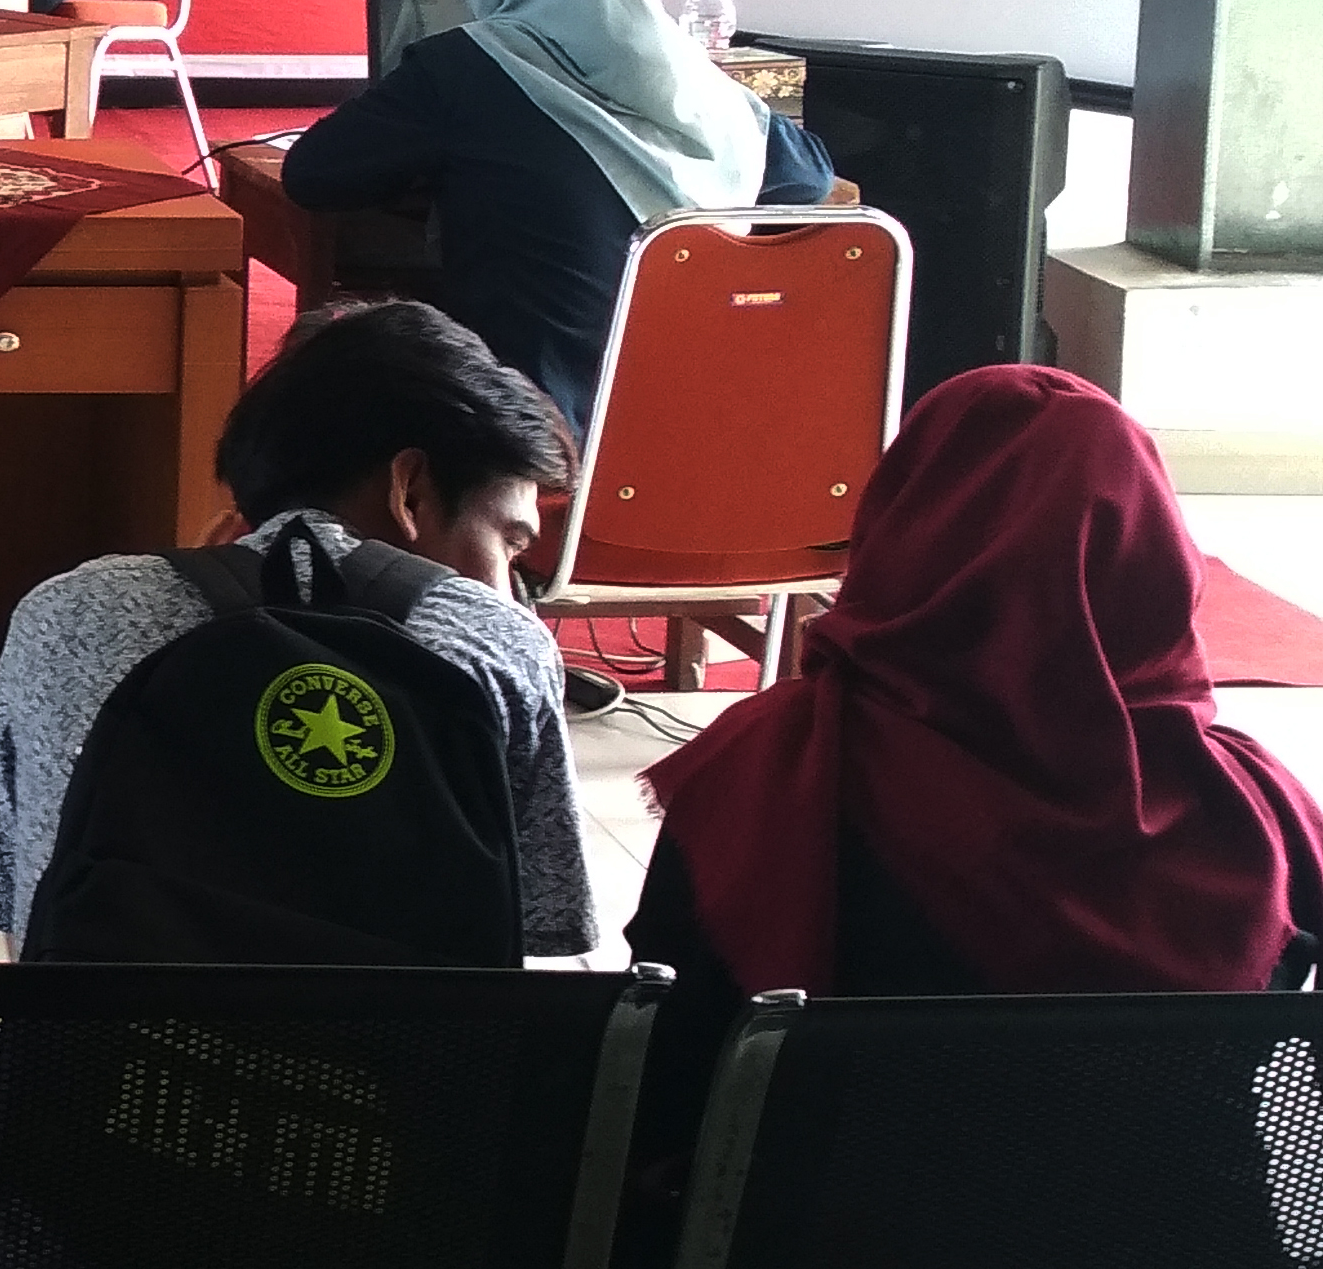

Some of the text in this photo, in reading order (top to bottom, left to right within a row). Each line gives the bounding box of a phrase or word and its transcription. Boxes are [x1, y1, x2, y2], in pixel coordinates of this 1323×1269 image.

[279, 675, 380, 727] CONVERSE
[275, 745, 367, 784] ALL STAR
